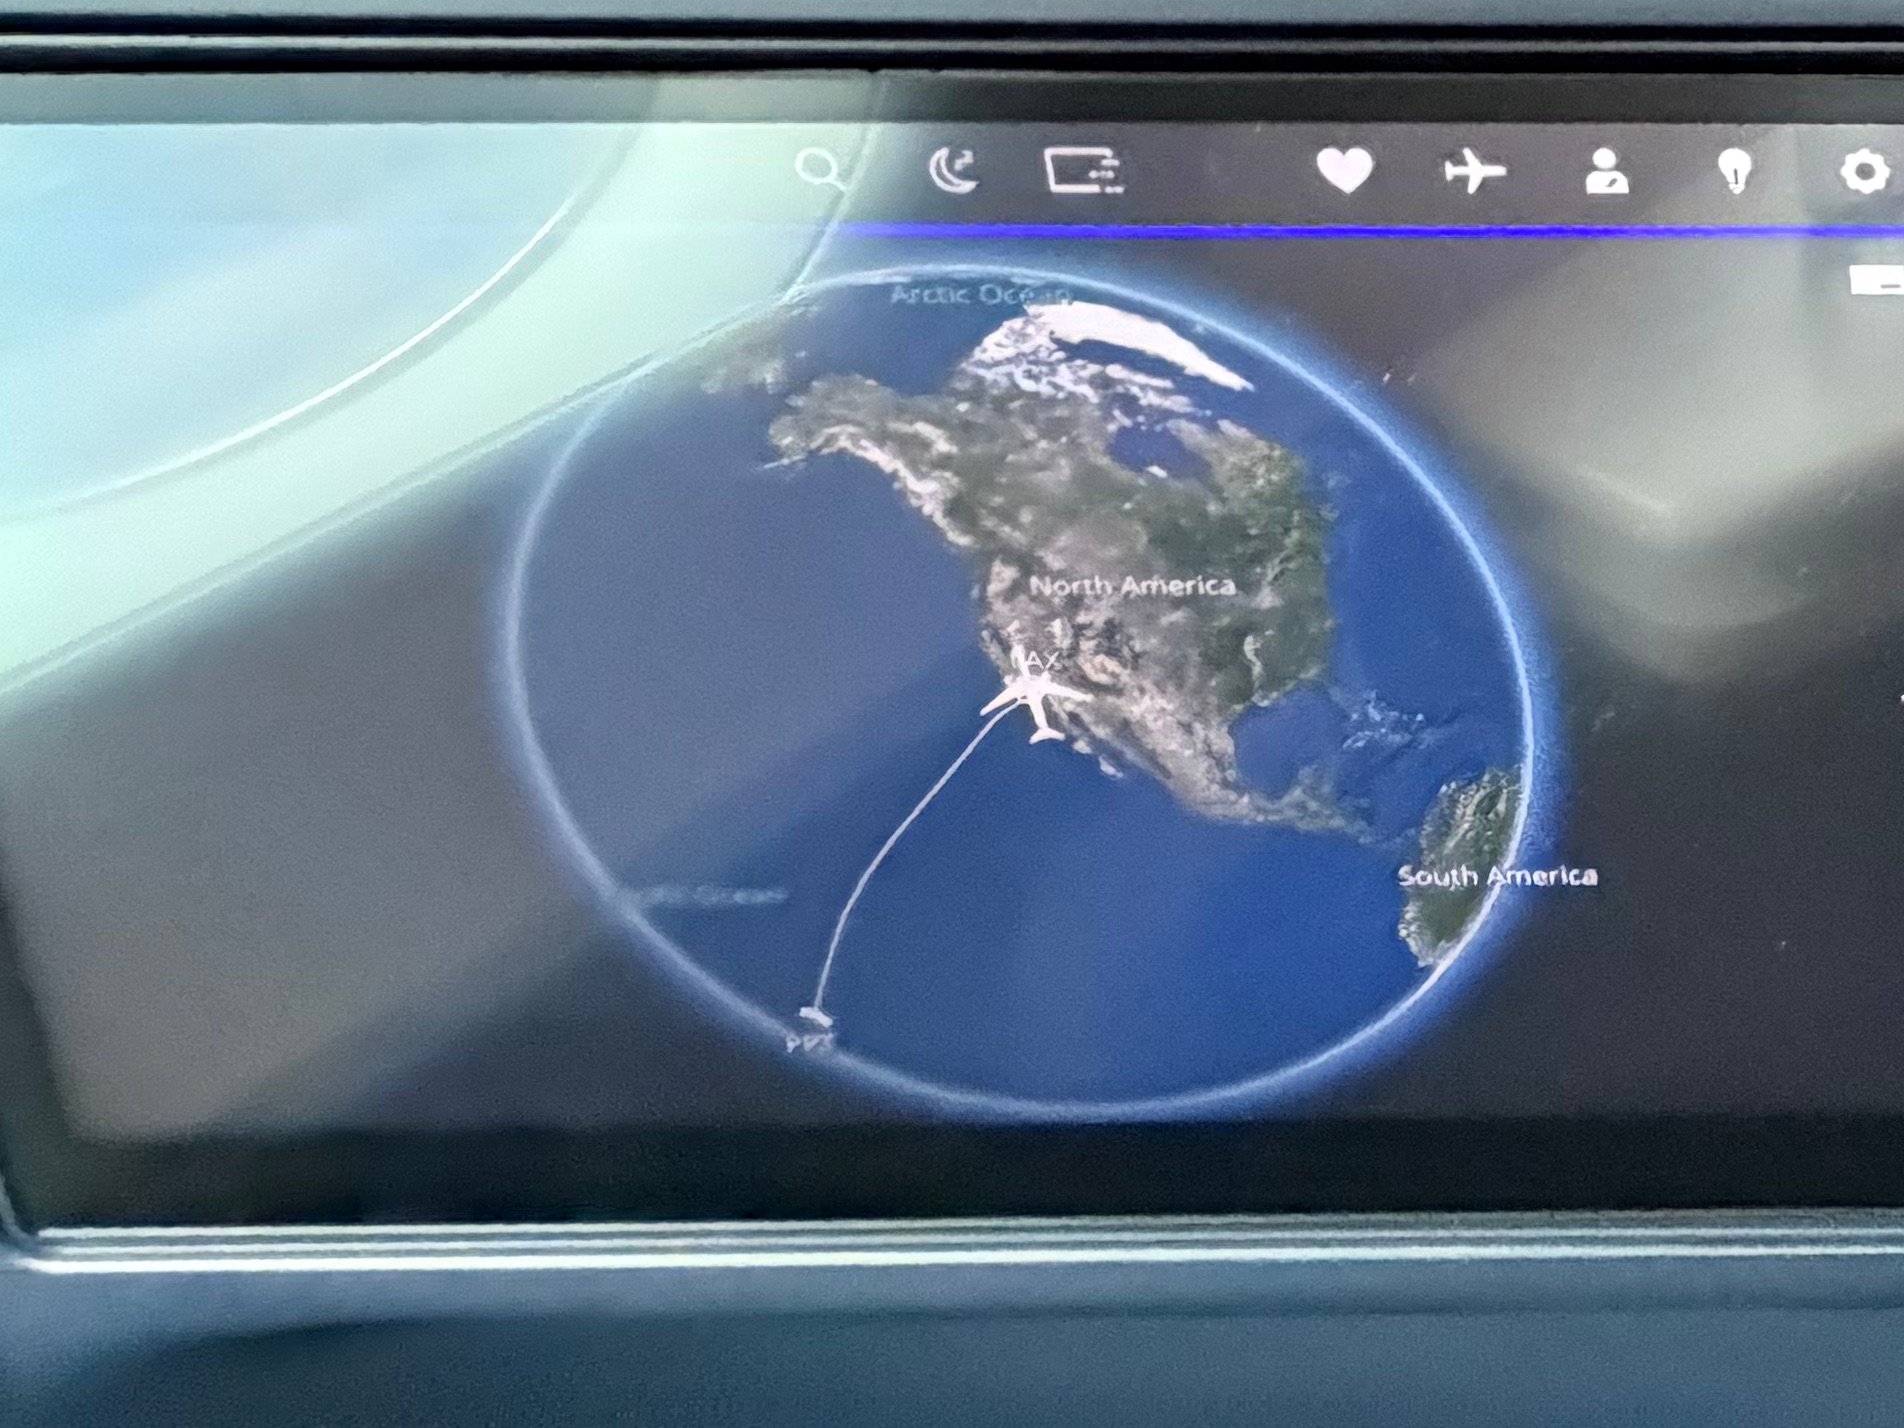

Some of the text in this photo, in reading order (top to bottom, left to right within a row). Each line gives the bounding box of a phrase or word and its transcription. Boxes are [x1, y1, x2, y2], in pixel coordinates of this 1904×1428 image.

[891, 284, 971, 304] Arctic
[1030, 575, 1237, 597] North America
[1398, 864, 1599, 887] South America
